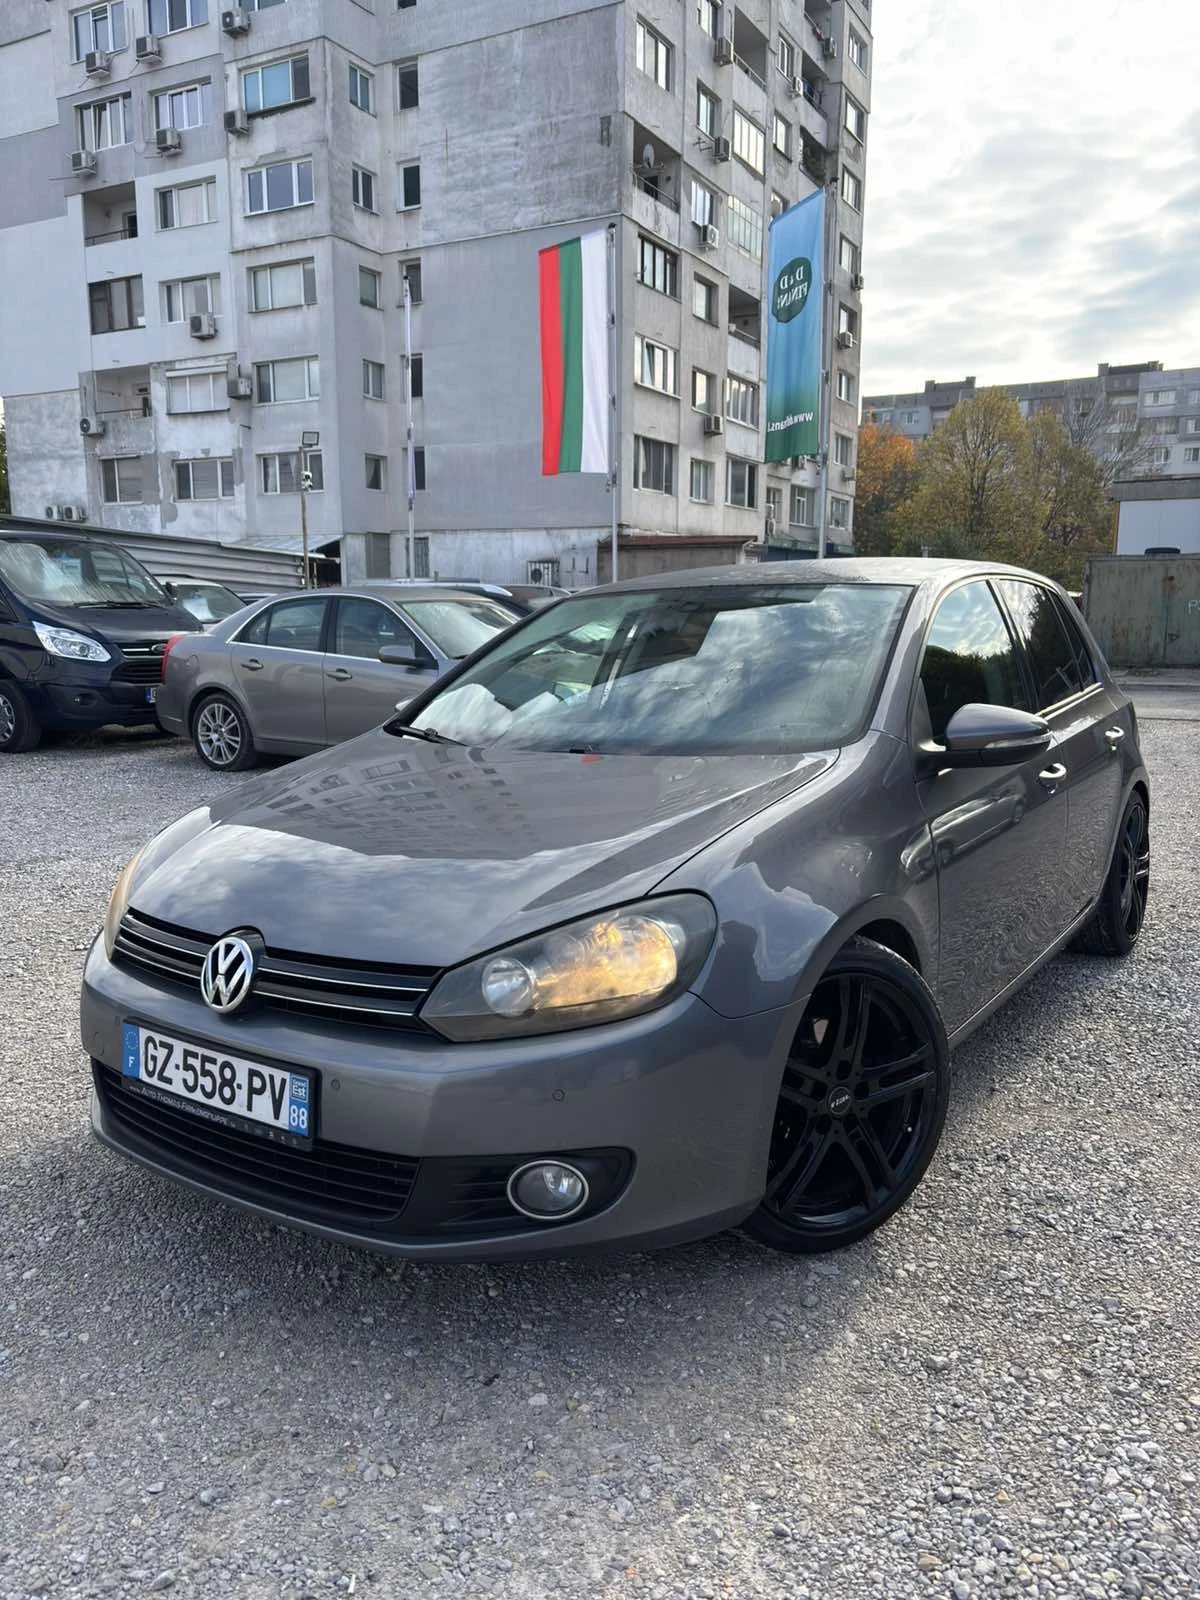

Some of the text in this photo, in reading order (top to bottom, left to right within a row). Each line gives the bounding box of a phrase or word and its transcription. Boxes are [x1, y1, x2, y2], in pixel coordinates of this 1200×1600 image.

[128, 1056, 135, 1068] F
[144, 1035, 287, 1121] GZ-558-PV
[290, 1105, 308, 1129] 88
